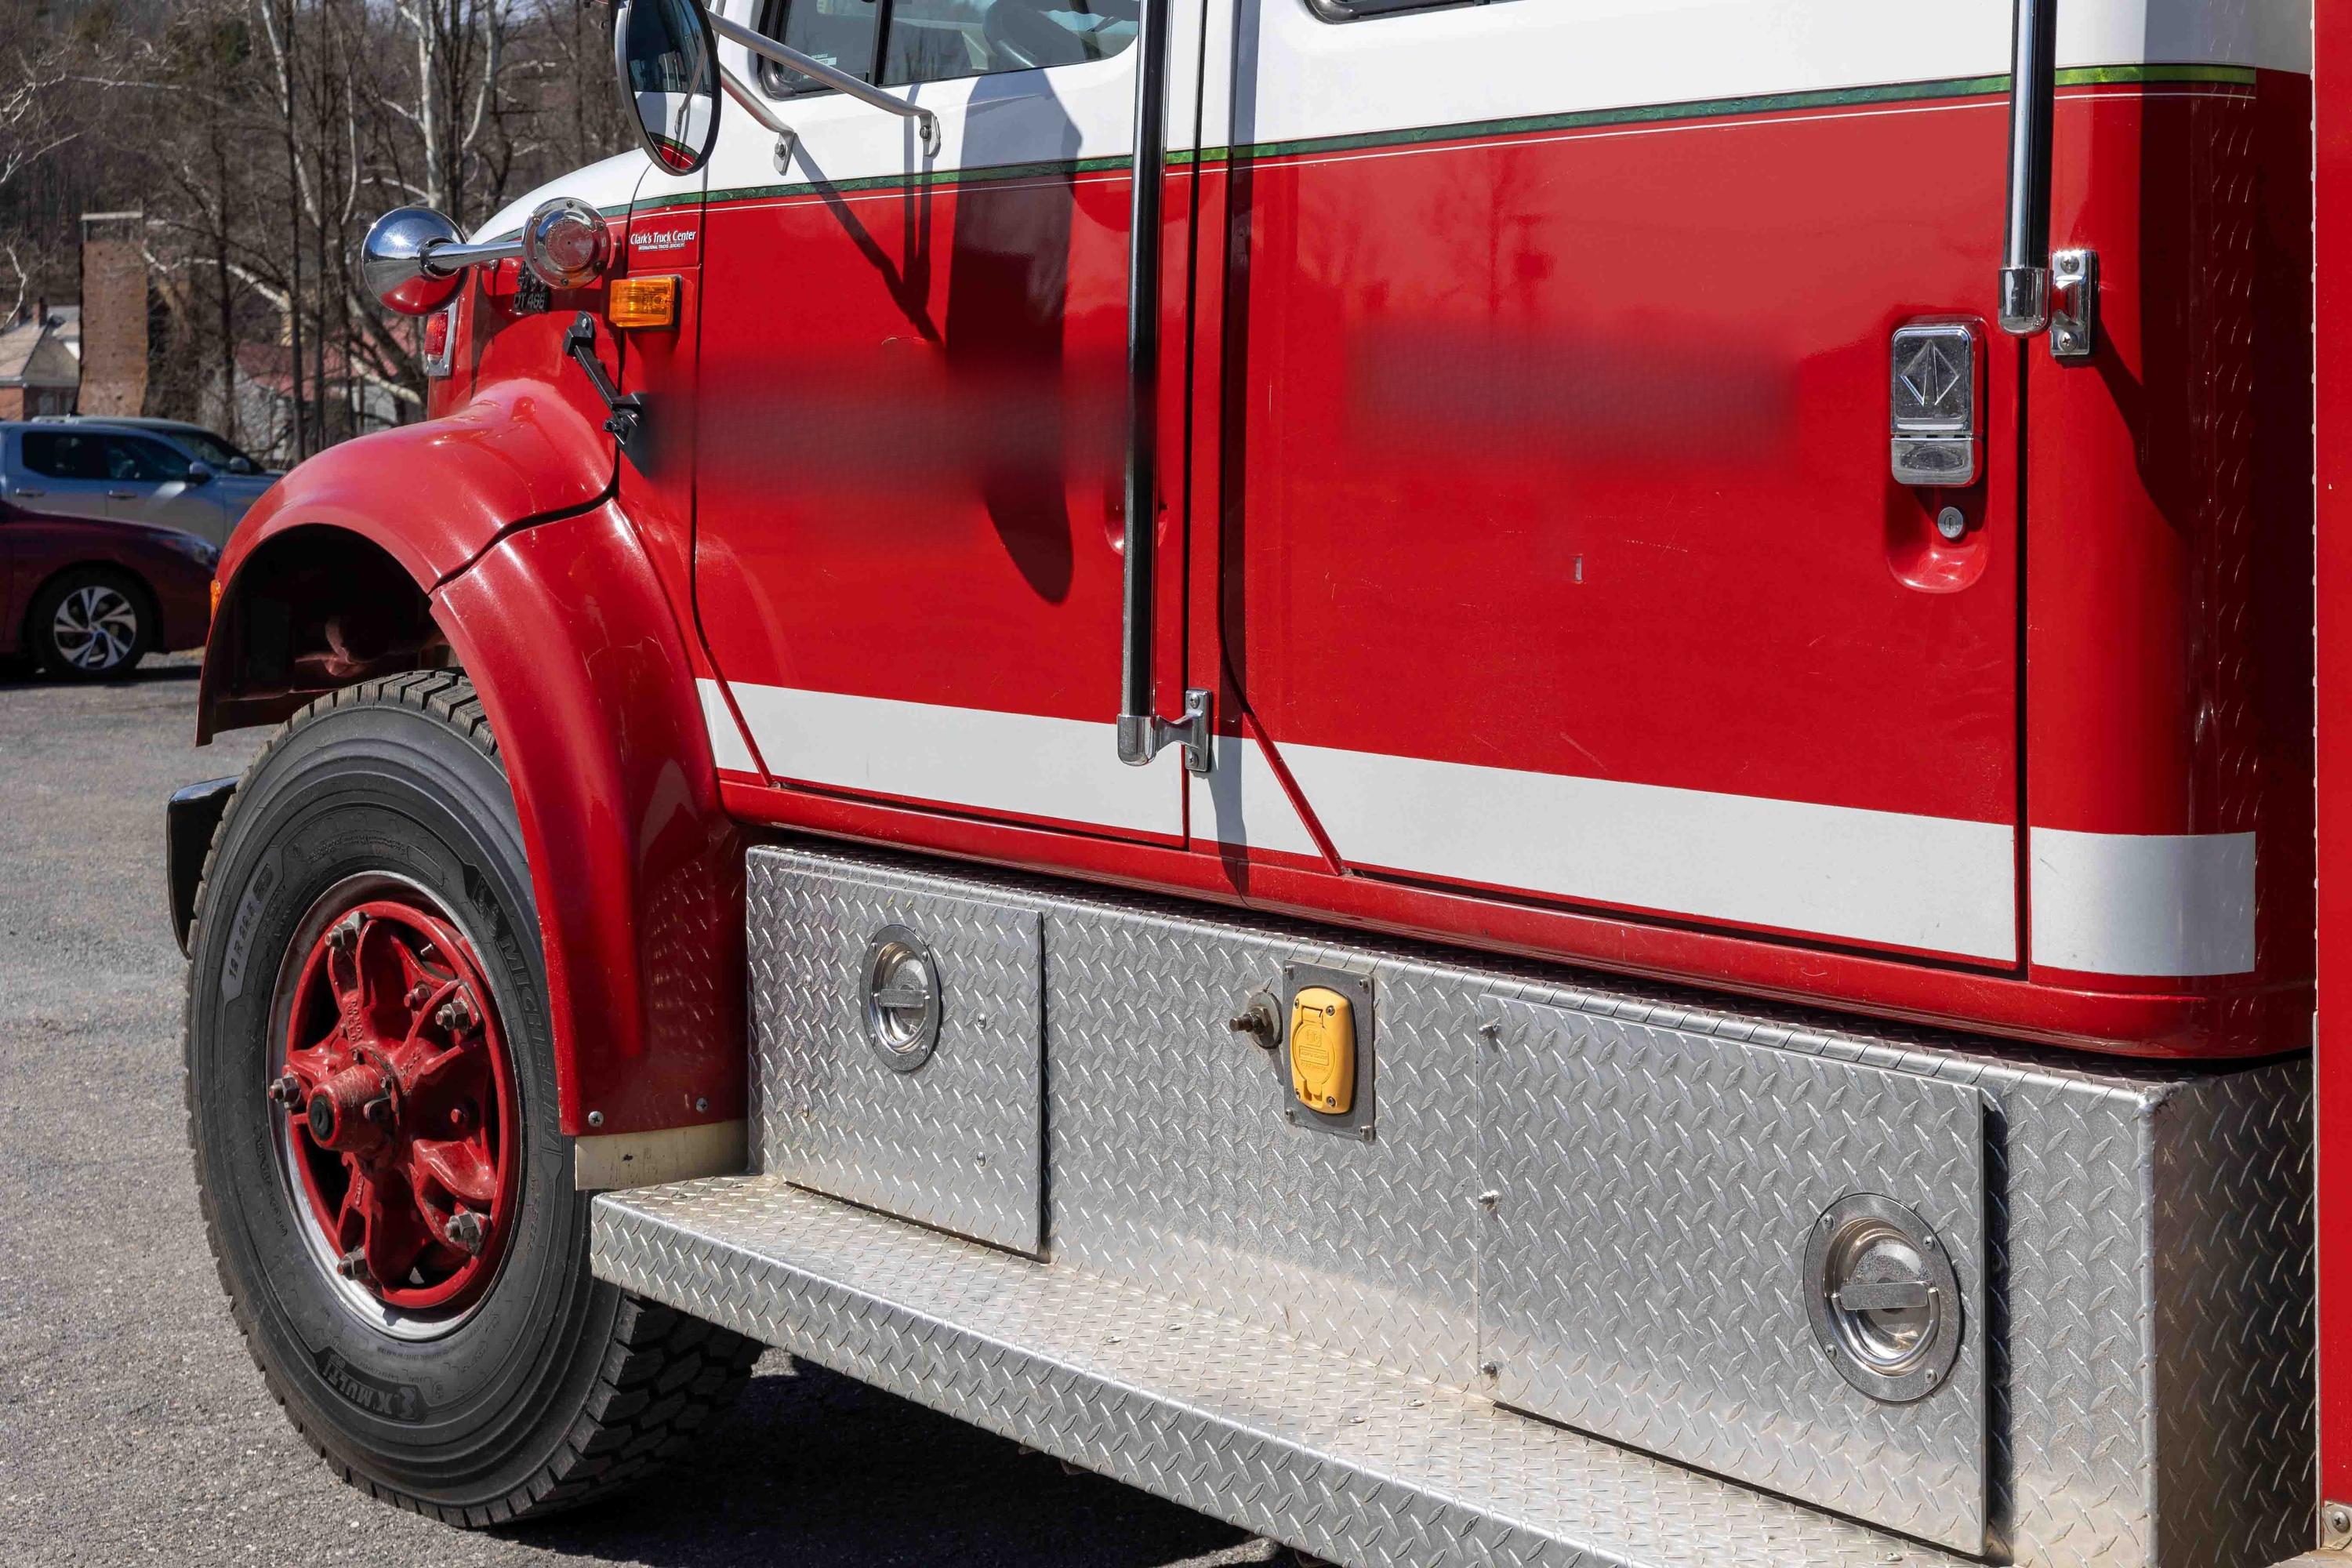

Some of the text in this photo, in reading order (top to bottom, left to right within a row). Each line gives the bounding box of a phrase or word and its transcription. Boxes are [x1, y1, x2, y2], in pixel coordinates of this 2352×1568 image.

[630, 230, 696, 245] Clark's Truck Center
[499, 935, 561, 1152] MICHELIN
[321, 1363, 376, 1409] MULTI
